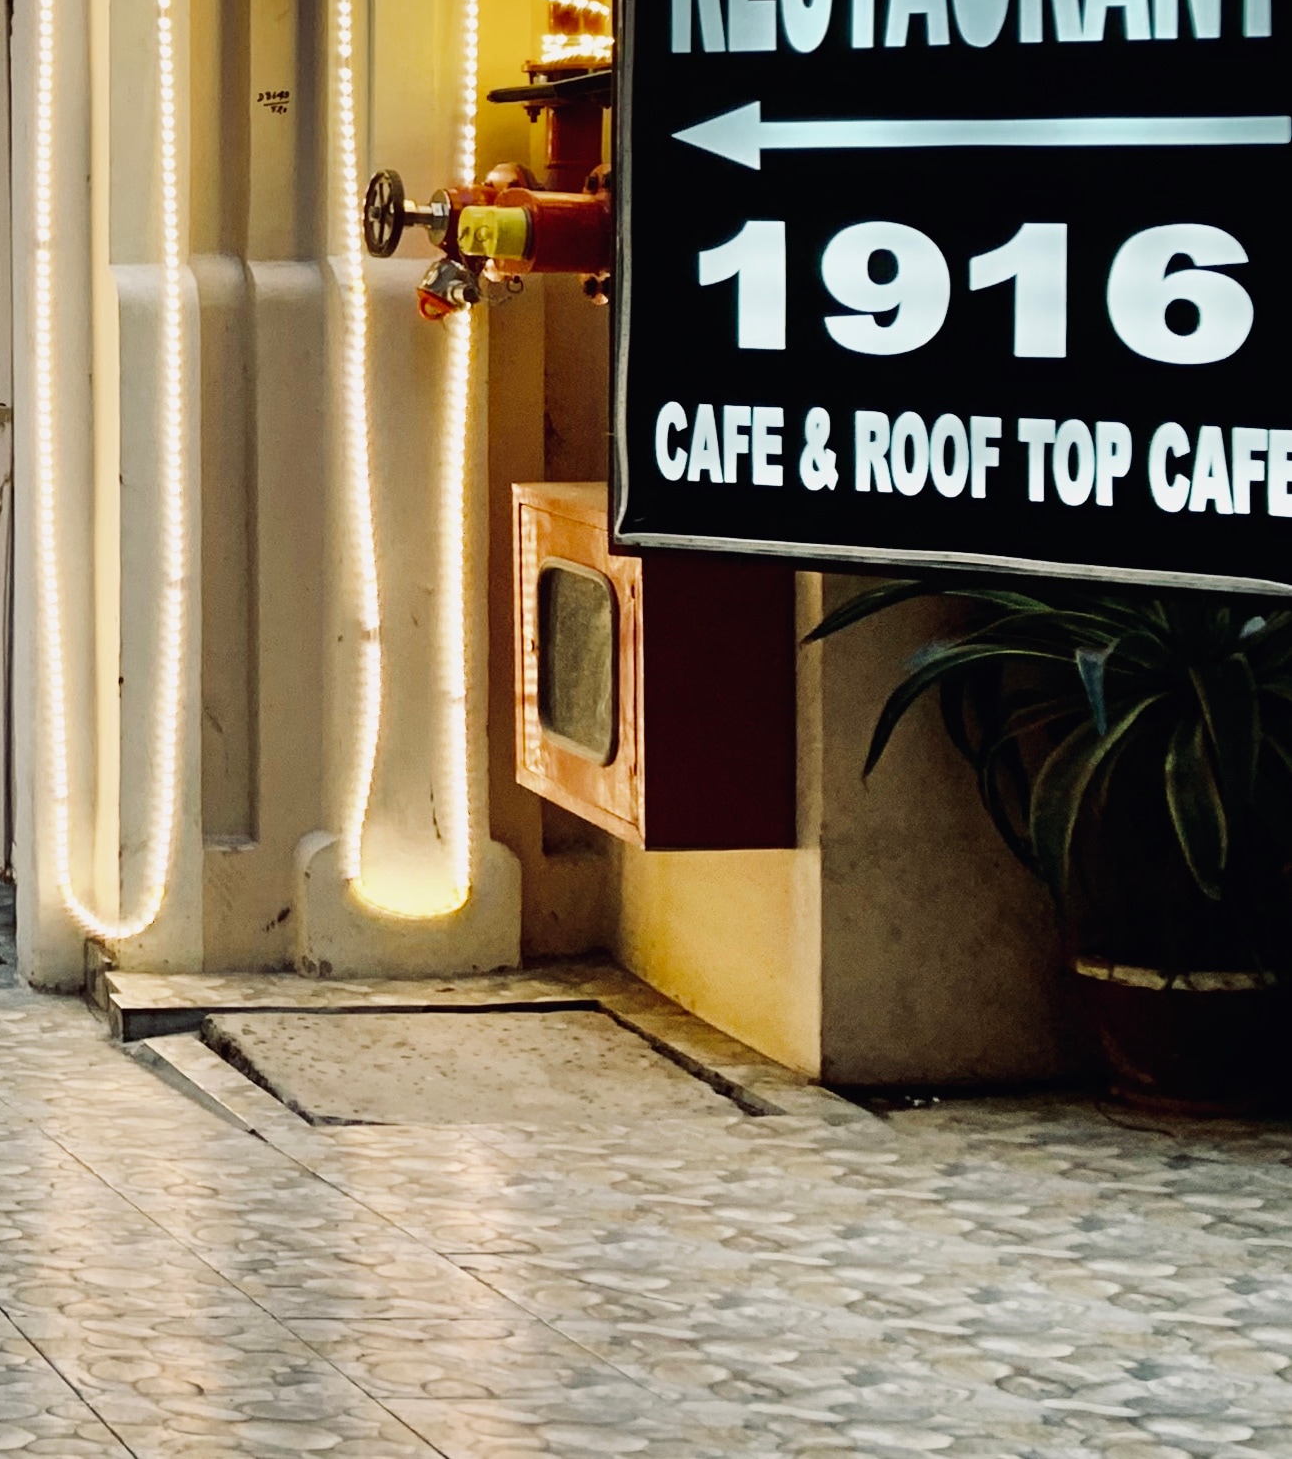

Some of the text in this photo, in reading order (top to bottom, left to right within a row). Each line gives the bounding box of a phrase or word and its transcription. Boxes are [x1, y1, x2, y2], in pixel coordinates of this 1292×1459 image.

[699, 221, 1253, 364] 1916
[656, 402, 1292, 517] CAFE & ROOF TOP CAFE
